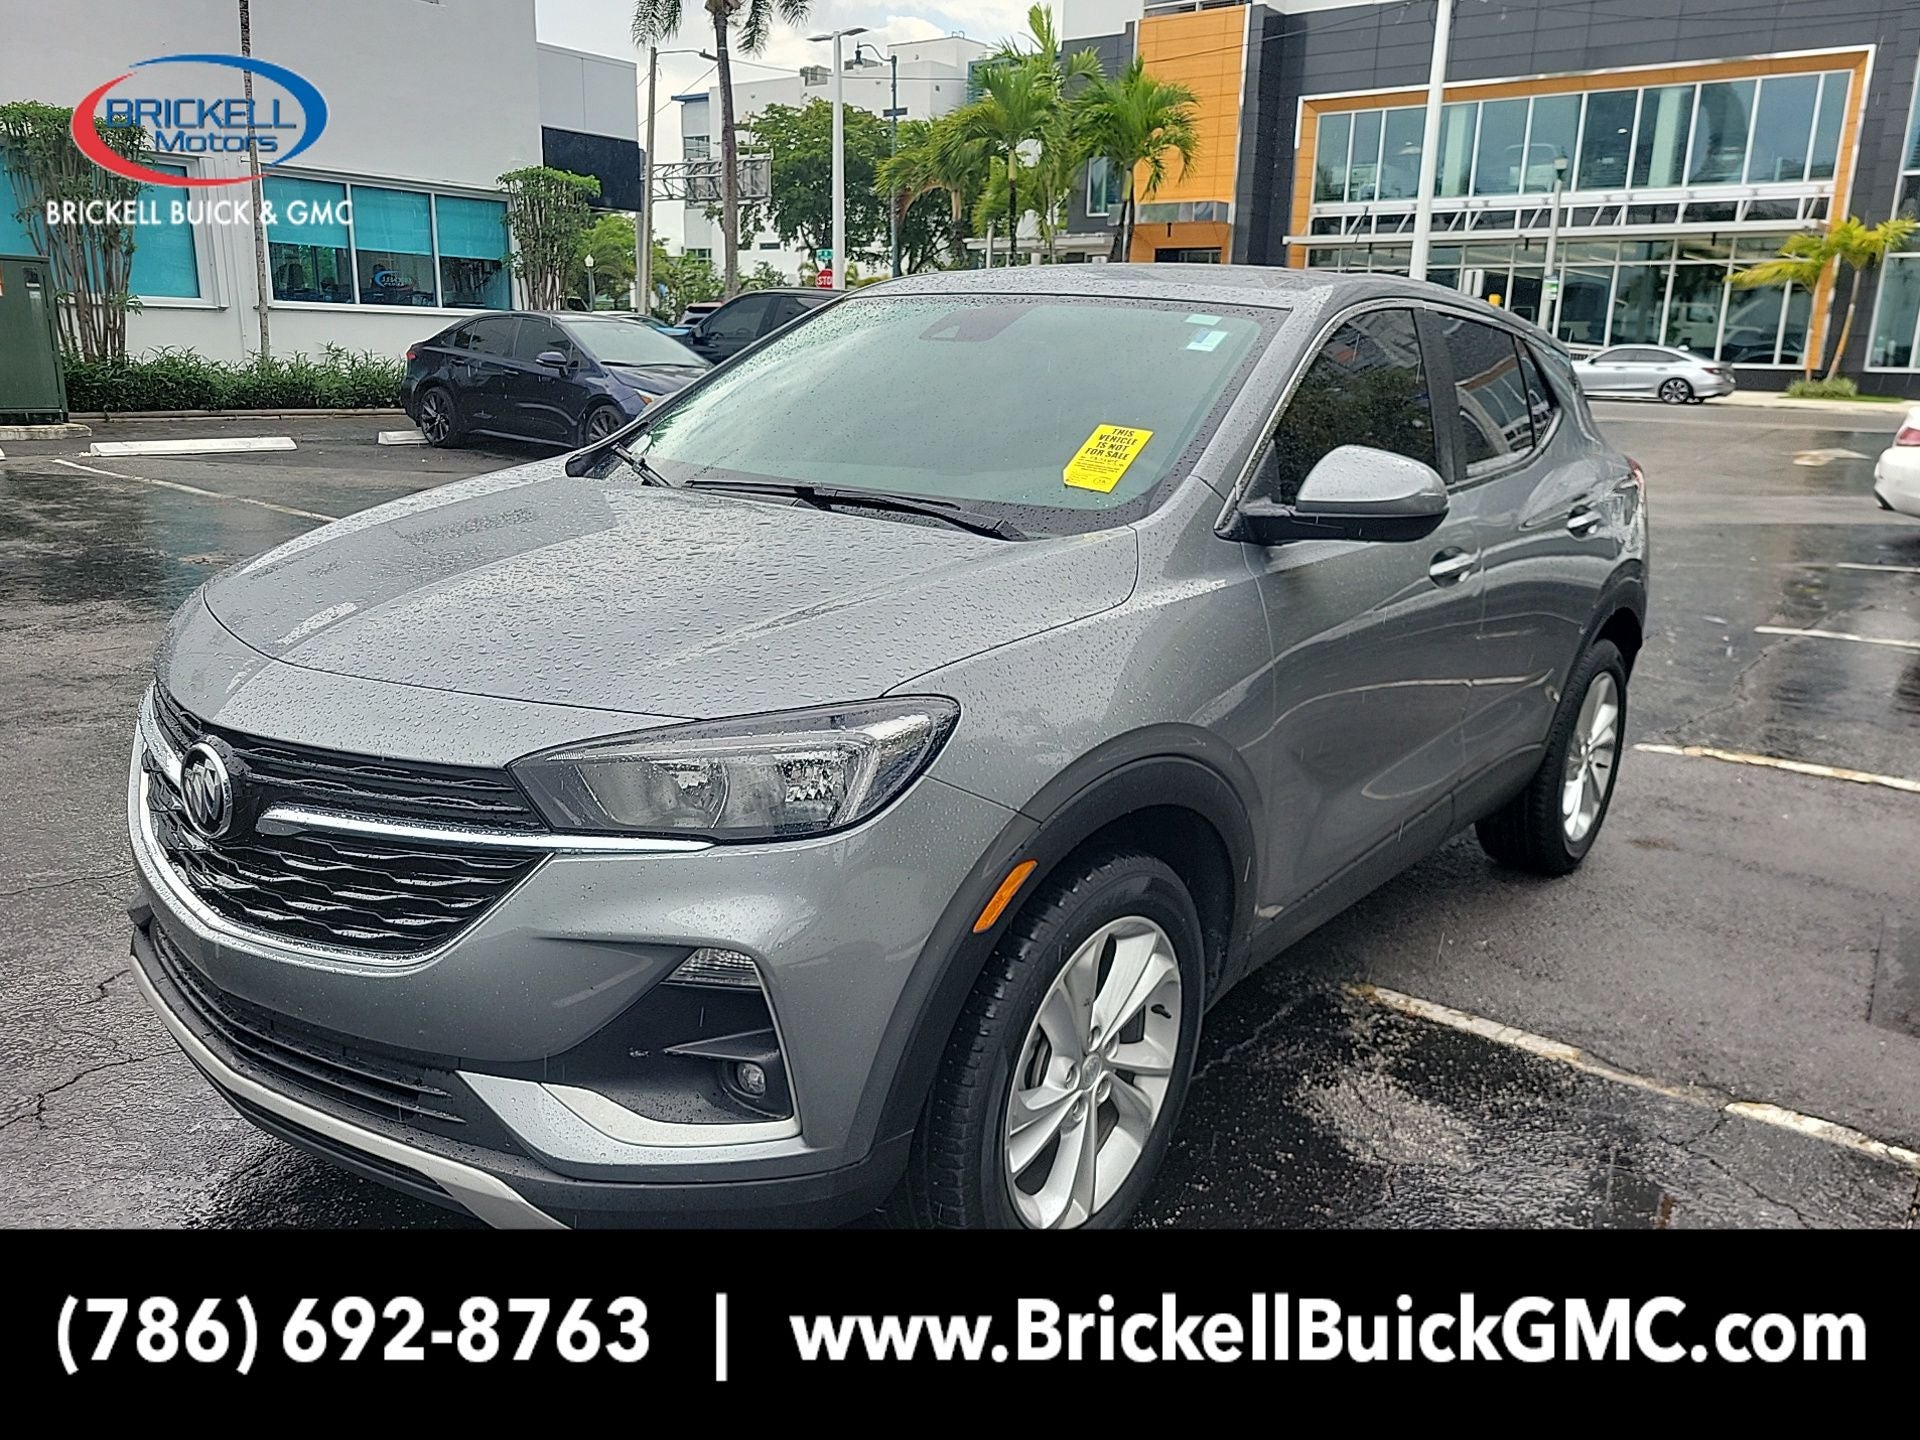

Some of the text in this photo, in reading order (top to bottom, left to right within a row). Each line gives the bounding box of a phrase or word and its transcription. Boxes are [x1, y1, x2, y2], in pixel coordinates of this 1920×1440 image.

[817, 276, 832, 286] STO
[1112, 429, 1135, 437] THIS
[1099, 434, 1138, 445] VEHICLE
[1108, 444, 1129, 452] NOT
[1085, 448, 1130, 460] FOR SALE
